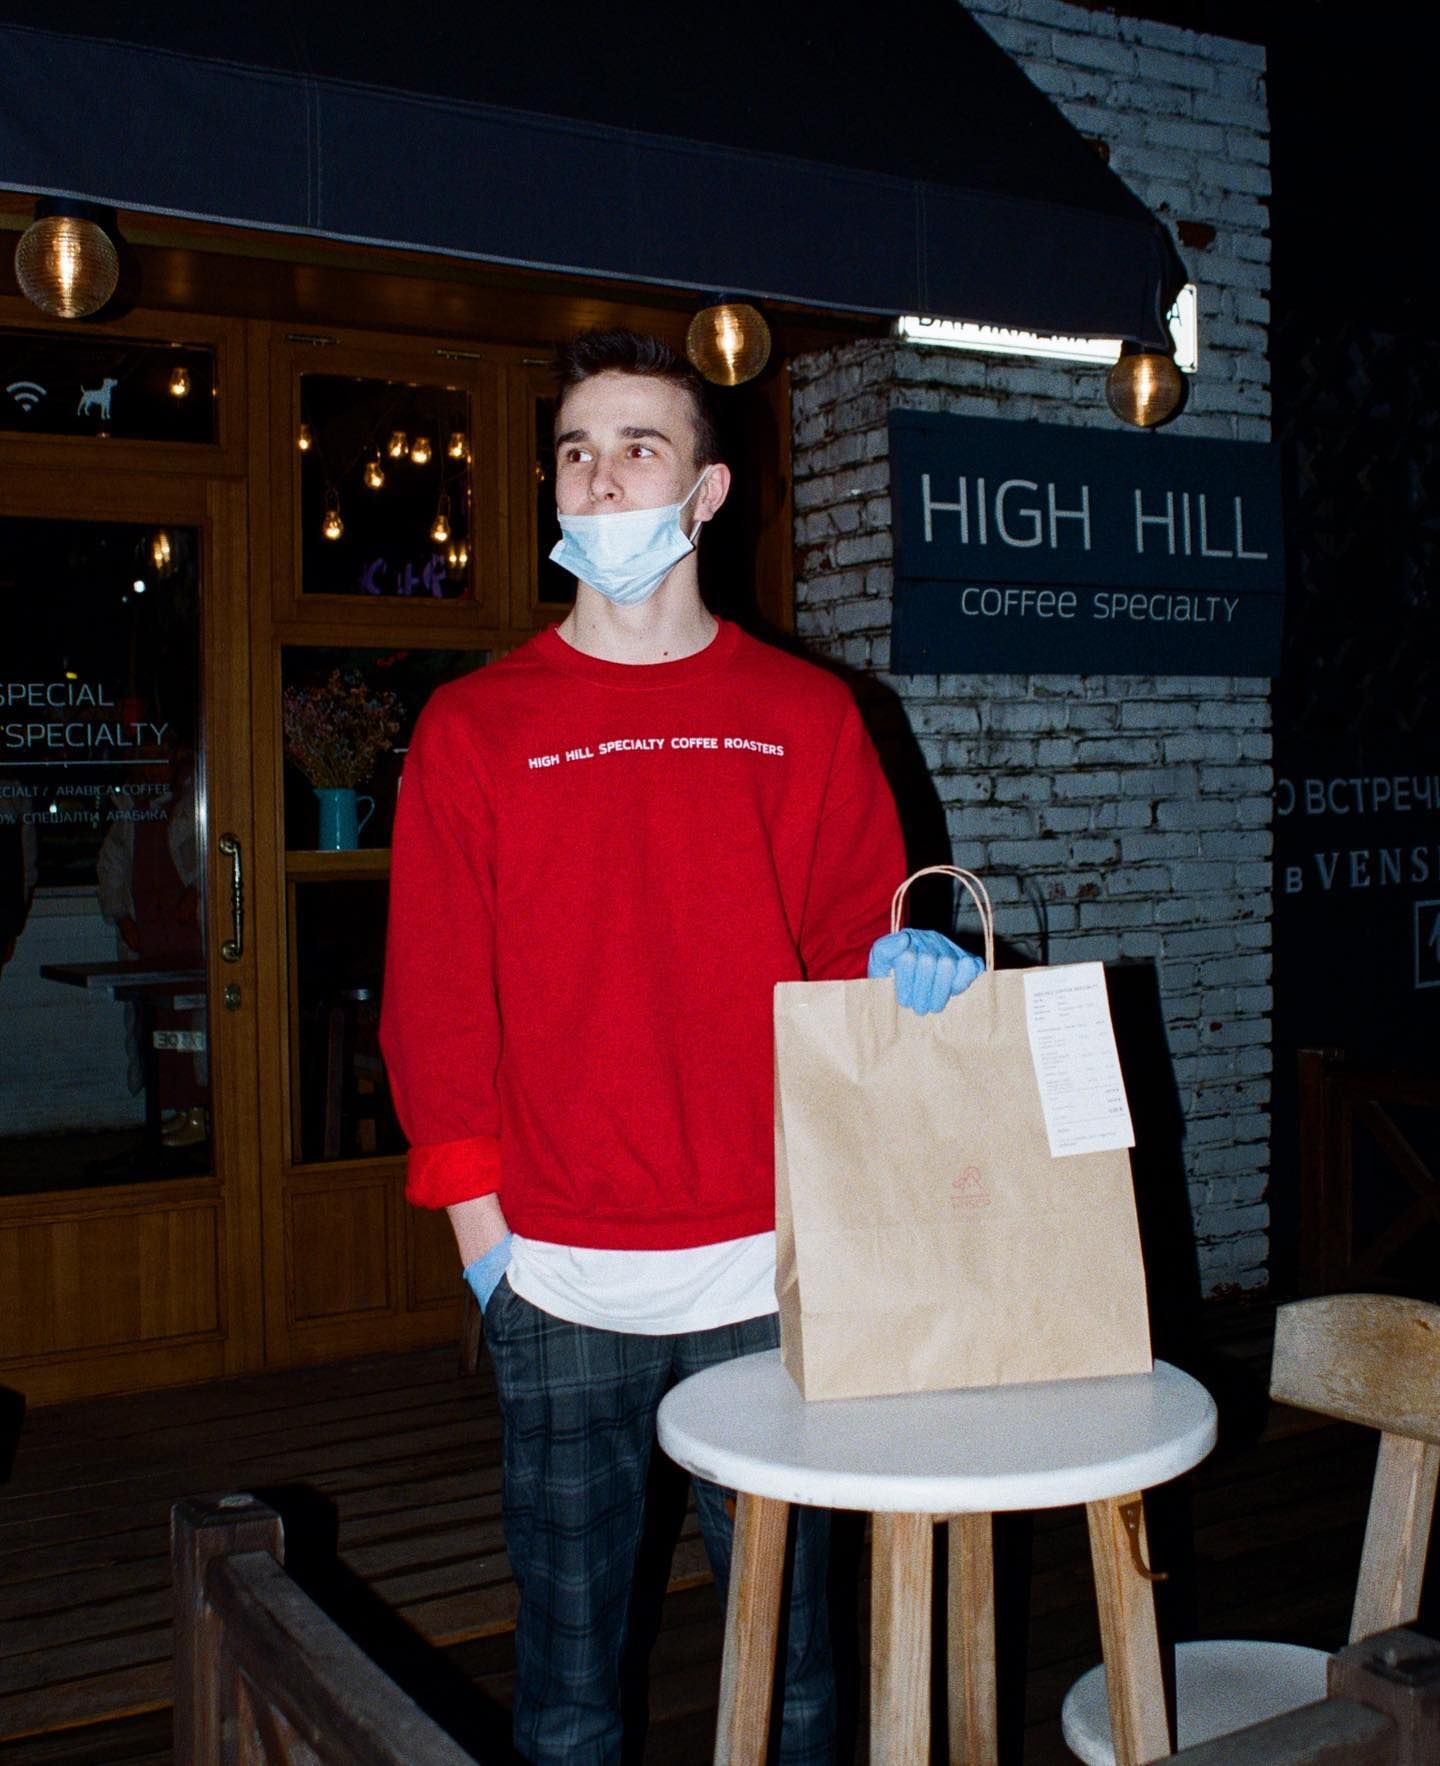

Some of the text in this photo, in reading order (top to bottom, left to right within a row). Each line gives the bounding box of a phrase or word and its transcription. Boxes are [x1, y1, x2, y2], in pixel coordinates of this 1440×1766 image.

[921, 473, 1269, 560] HIGH HILL
[5, 722, 169, 748] SPECIALTY
[528, 737, 785, 770] HIGH HILL SPECIALTY COFFEE ROASTERS
[1314, 845, 1440, 891] VENS
